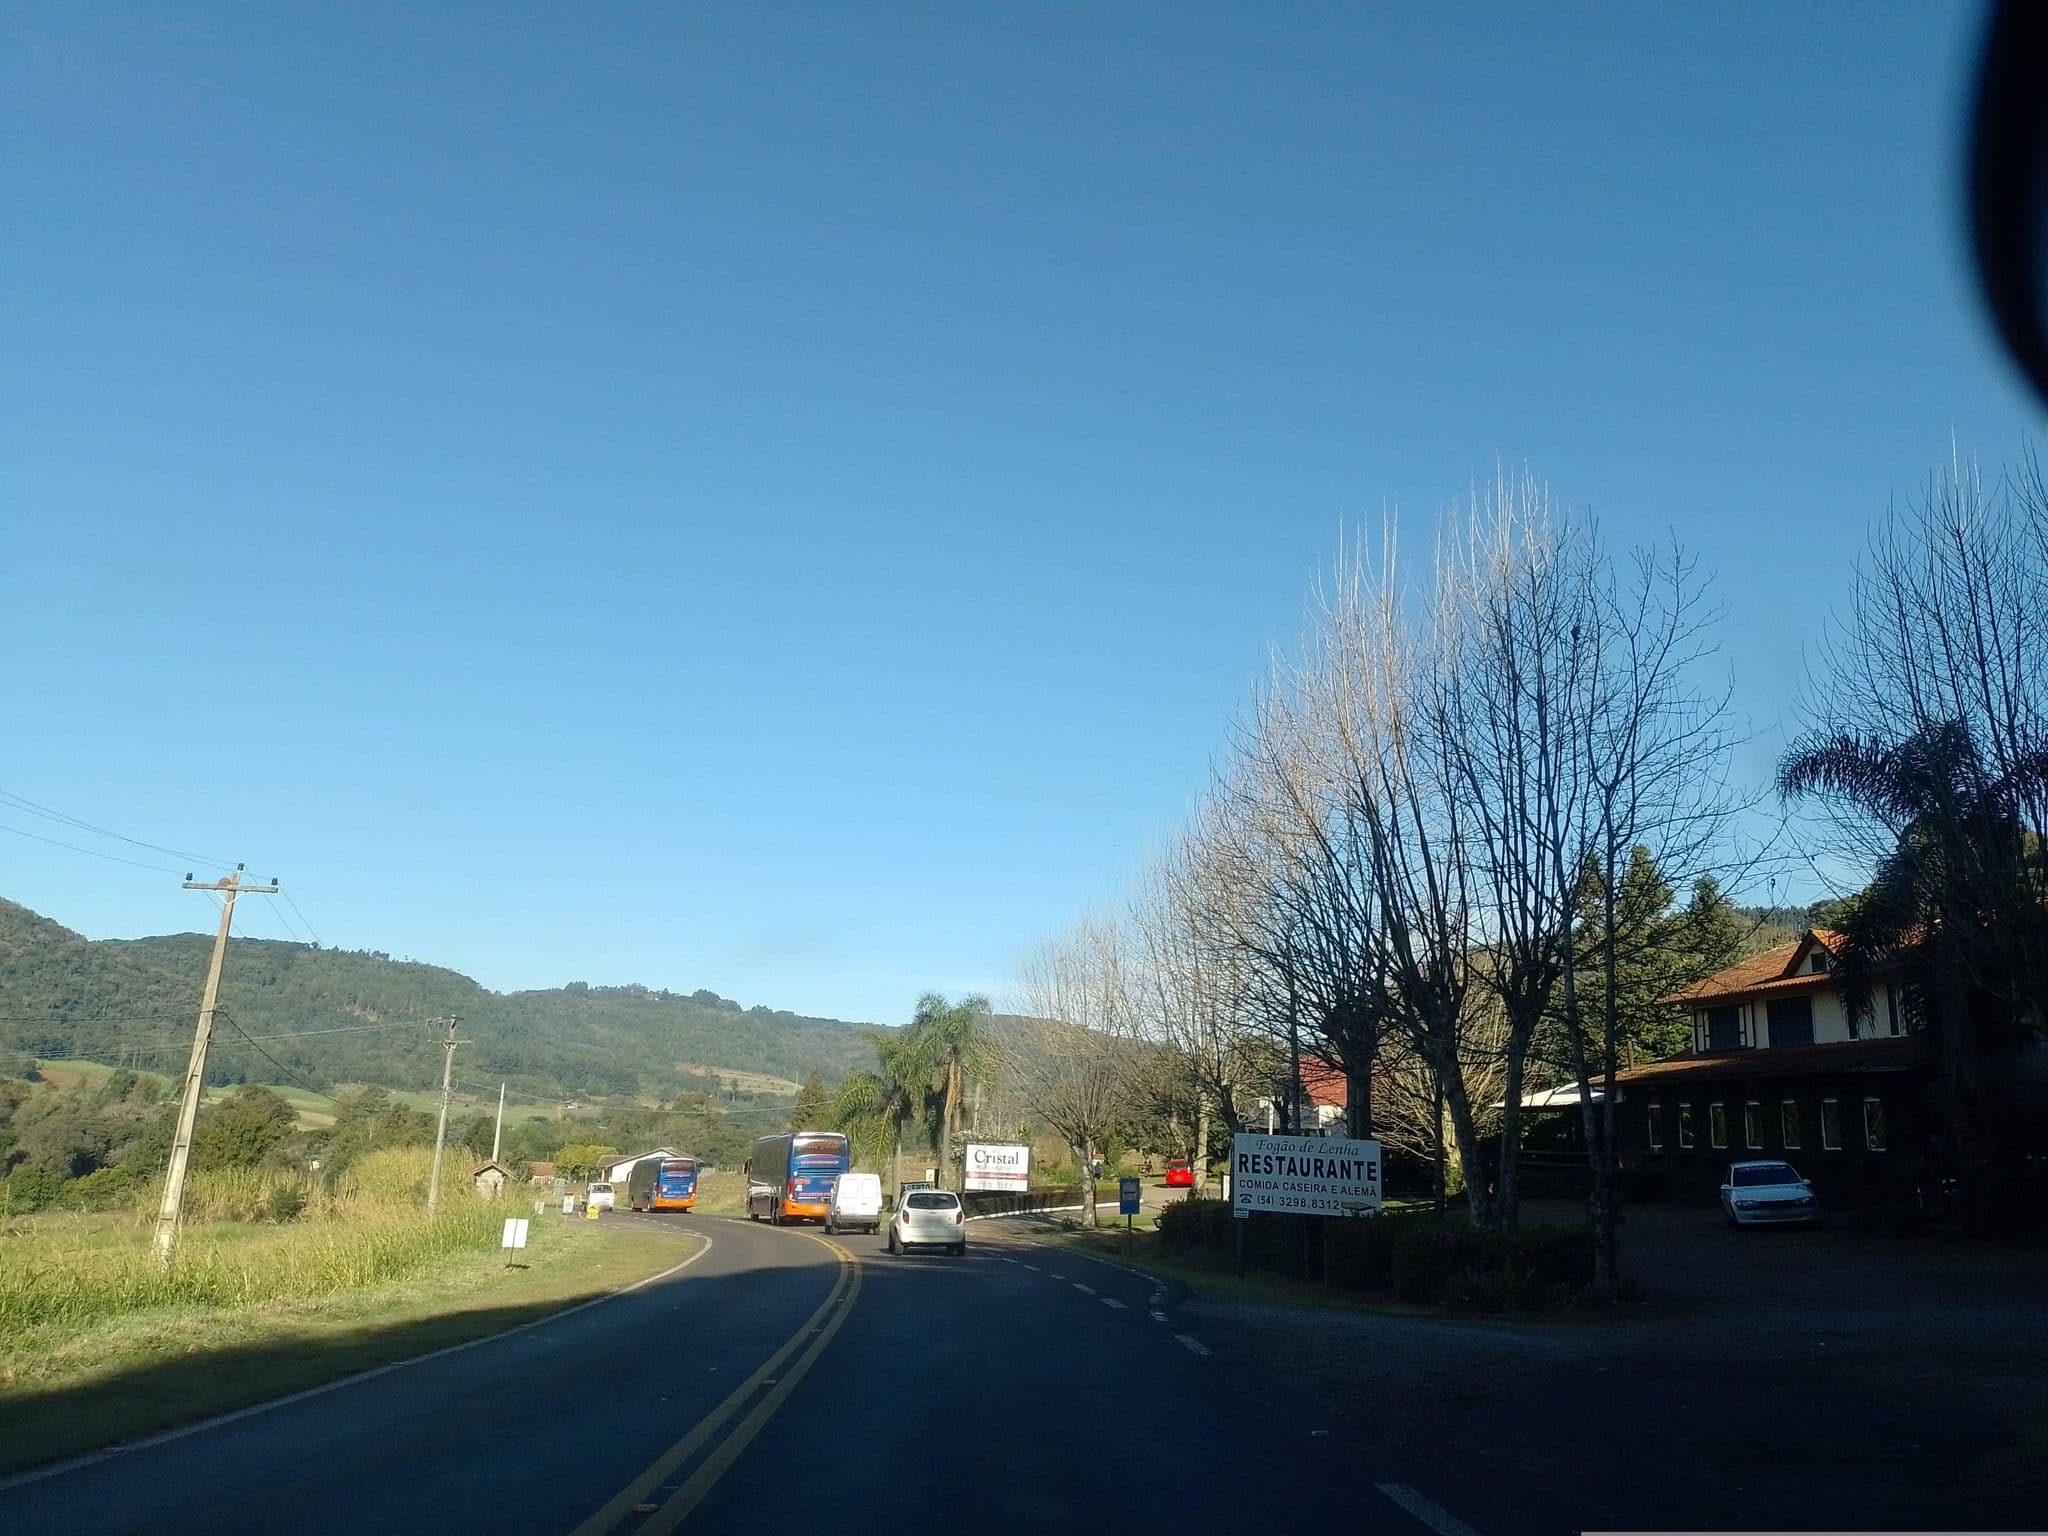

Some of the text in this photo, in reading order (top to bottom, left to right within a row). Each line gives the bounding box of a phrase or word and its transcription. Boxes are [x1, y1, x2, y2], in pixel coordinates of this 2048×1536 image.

[1256, 1139, 1359, 1156] Fogão de Lenha
[974, 1149, 1019, 1165] Cristal
[1239, 1153, 1377, 1181] RESTAURANTE
[1239, 1179, 1377, 1197] COMIDA CASEIRA E ALEMÃ
[1257, 1195, 1340, 1210] (54) 3298.8312
